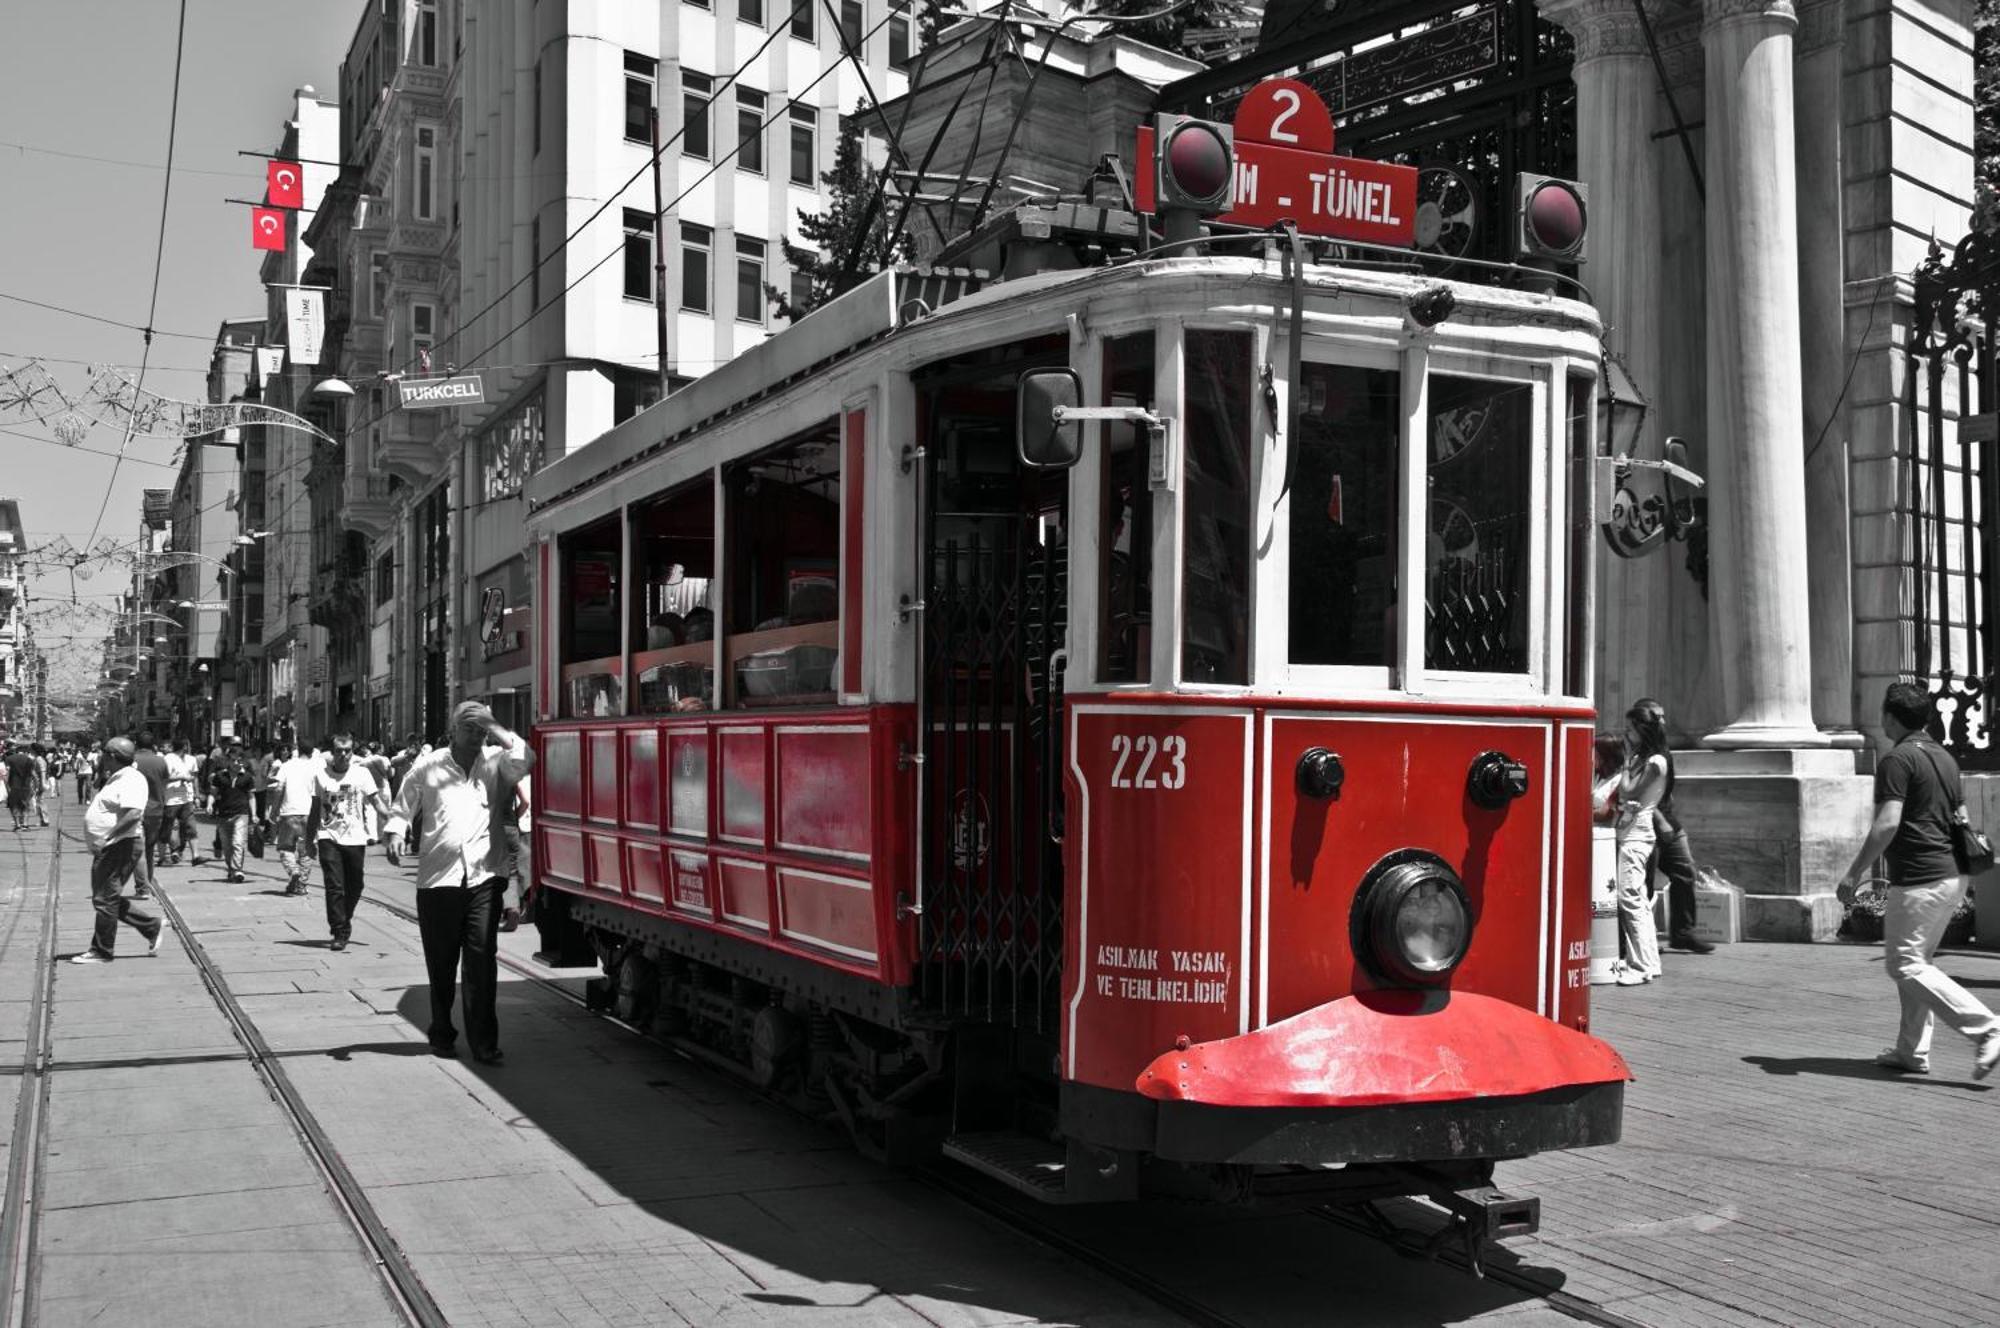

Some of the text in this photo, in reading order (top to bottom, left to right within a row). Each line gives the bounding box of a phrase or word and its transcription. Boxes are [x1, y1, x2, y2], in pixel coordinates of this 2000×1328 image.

[1270, 89, 1300, 143] 2
[1233, 153, 1259, 206] İM
[1309, 168, 1401, 226] TÜNEL
[403, 383, 481, 401] TURKCELL
[1111, 735, 1186, 790] 223
[1097, 944, 1226, 973] ASILMAK YASAK
[1097, 973, 1226, 1004] VE TEHLİKELİDİR
[1568, 968, 1580, 989] VE
